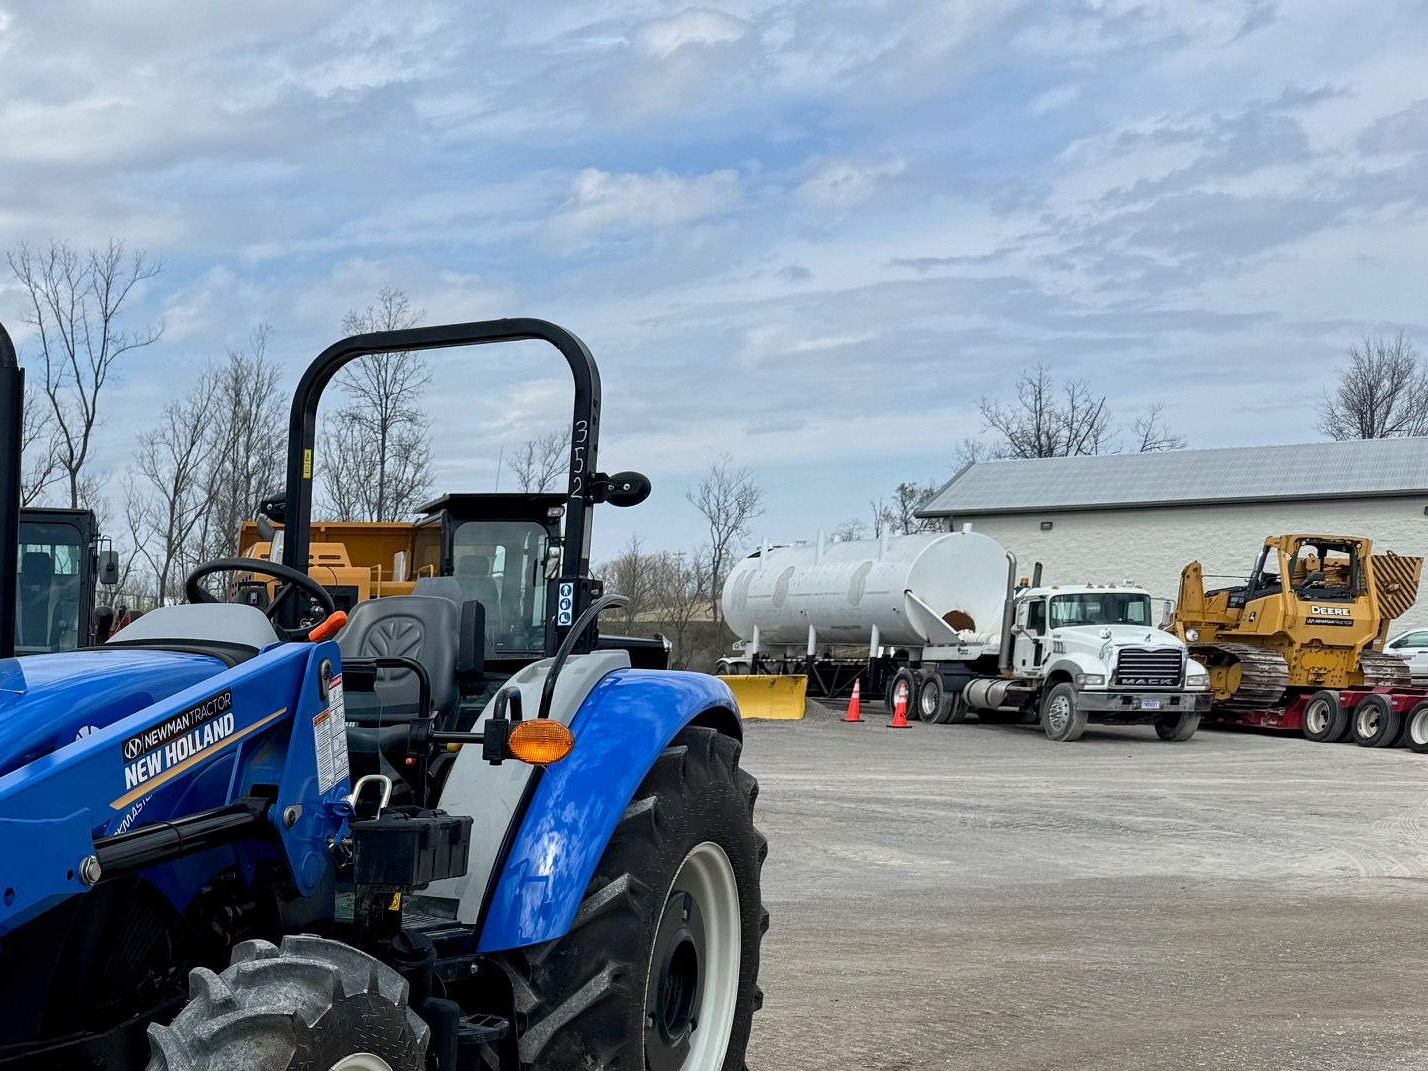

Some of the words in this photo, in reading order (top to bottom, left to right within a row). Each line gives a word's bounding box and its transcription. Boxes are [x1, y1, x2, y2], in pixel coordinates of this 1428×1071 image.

[1310, 605, 1351, 616] DEERE
[124, 750, 162, 790] NEW
[165, 712, 235, 768] HOLLAND
